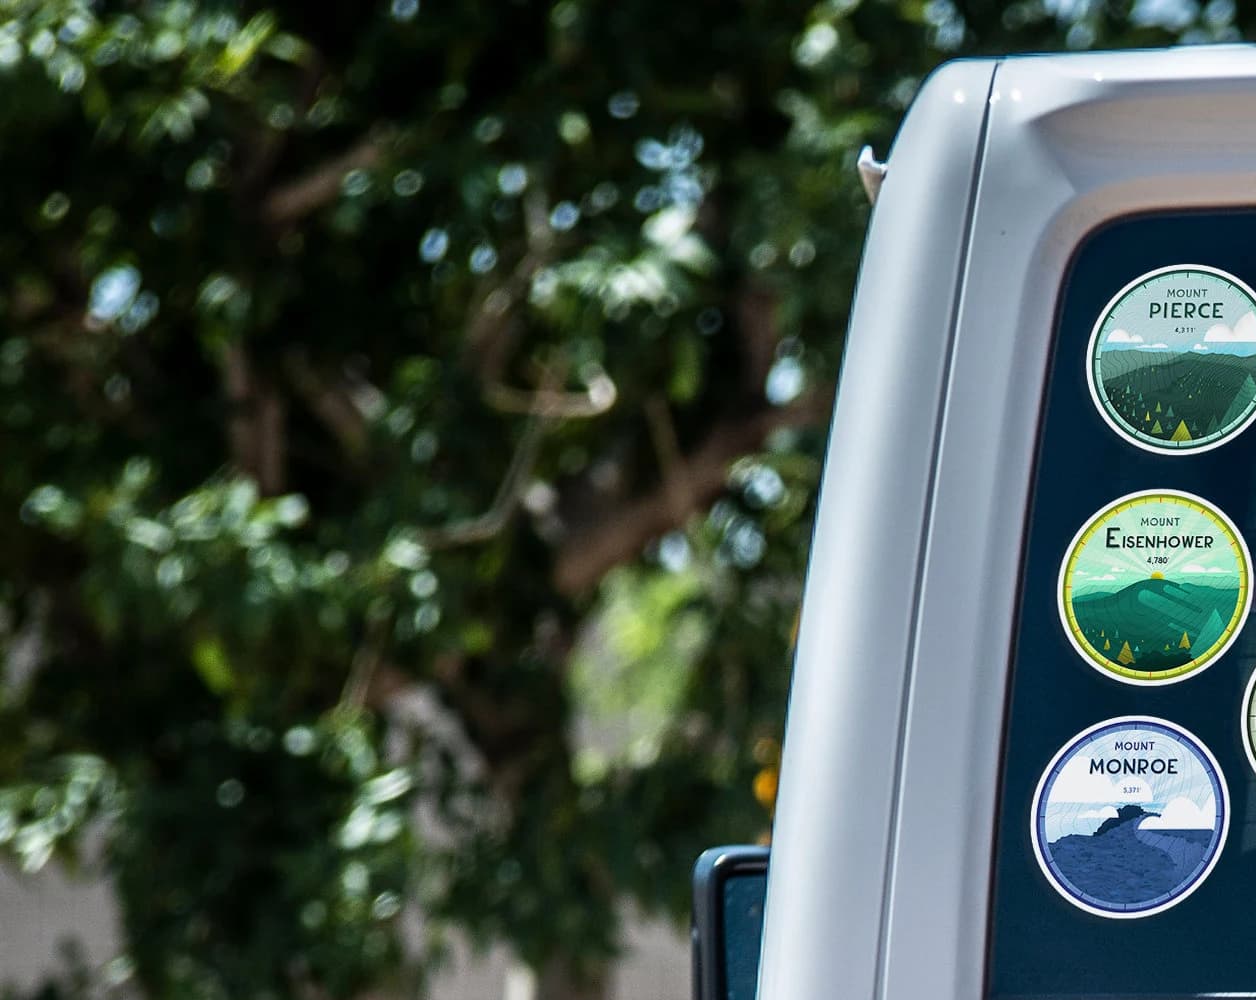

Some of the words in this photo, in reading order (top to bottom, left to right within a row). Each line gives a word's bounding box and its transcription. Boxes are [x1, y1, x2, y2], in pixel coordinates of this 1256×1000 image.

[1167, 289, 1208, 298] MOUNT
[1149, 302, 1224, 318] PIERCE
[1140, 517, 1181, 526] MOUNT
[1105, 527, 1214, 548] EISENHOWER
[1114, 741, 1156, 751] MOUNT
[1089, 758, 1179, 775] MONROE
